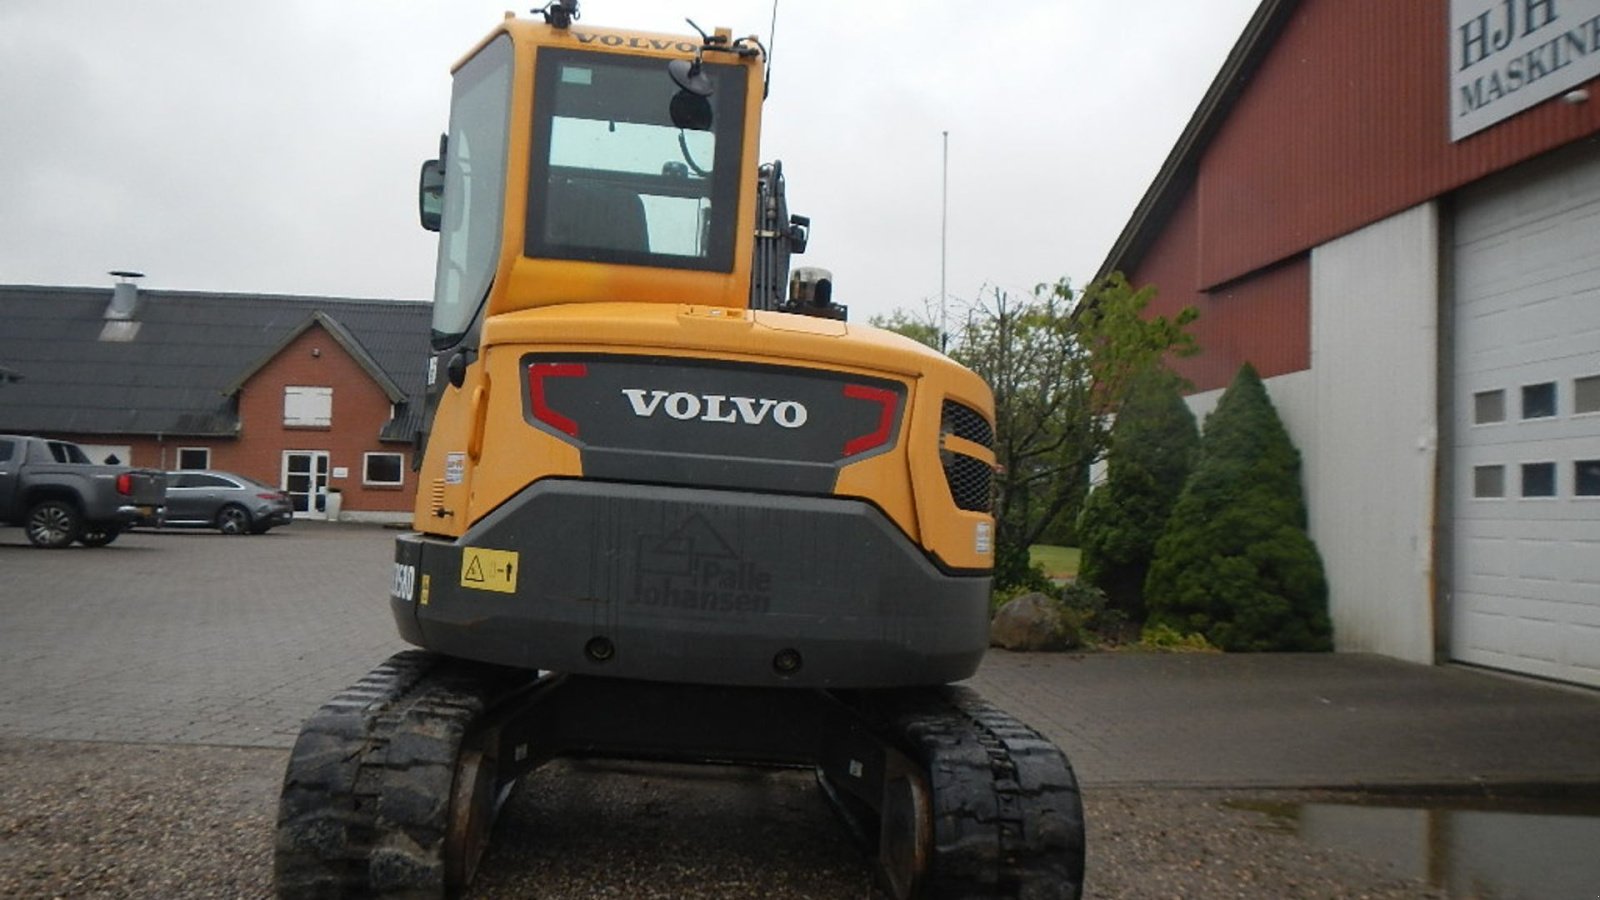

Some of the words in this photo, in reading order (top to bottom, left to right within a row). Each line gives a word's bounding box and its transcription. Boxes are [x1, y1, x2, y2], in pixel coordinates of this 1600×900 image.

[574, 32, 698, 53] VOLVO
[1458, 0, 1560, 71] HJH
[621, 388, 808, 429] VOLVO
[703, 558, 771, 592] Palle
